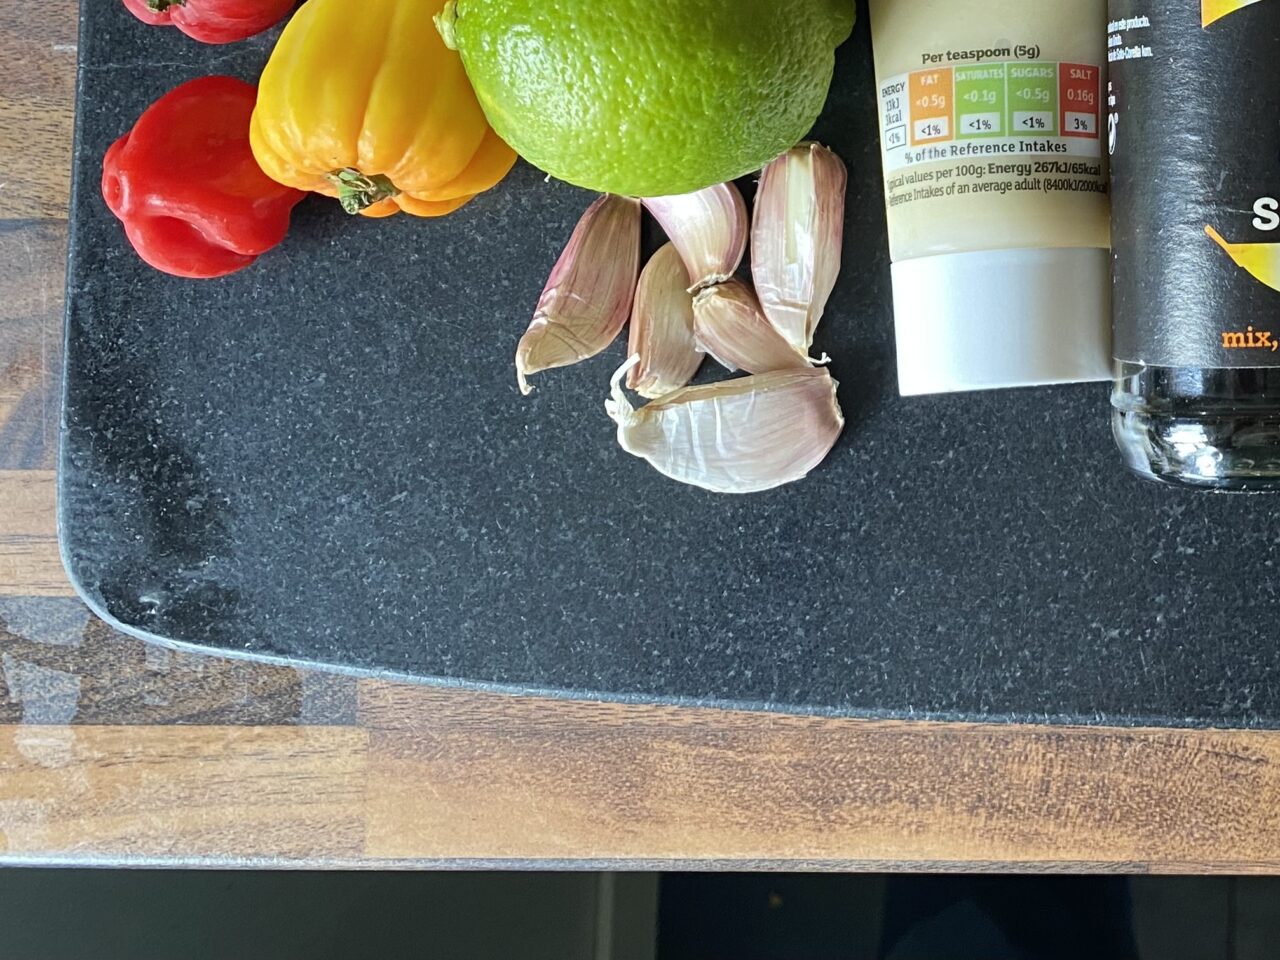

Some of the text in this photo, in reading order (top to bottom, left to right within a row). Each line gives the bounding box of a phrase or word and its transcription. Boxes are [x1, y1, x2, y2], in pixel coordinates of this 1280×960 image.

[922, 45, 1040, 64] Per teaspoon (5g)
[956, 68, 1004, 81] SATURATES
[1011, 68, 1053, 78] SUGARS
[1070, 69, 1092, 80] SALT
[921, 75, 939, 85] FAT
[882, 82, 905, 98] ENERGY
[1067, 89, 1093, 104] 0.16g
[969, 119, 991, 130] <1%
[1022, 117, 1044, 128] <1%
[1074, 119, 1087, 130] 3%
[922, 125, 940, 136] <1%
[905, 140, 1067, 164] % of the Reference Intakes
[905, 171, 933, 185] values
[936, 168, 953, 181] per
[955, 165, 986, 178] 100g:
[988, 163, 1031, 175] Energy
[914, 185, 944, 201] Intakes
[946, 182, 955, 195] of
[957, 184, 969, 194] an
[972, 181, 1012, 194] average
[1015, 178, 1040, 190] adult
[1222, 328, 1279, 351] mix,
